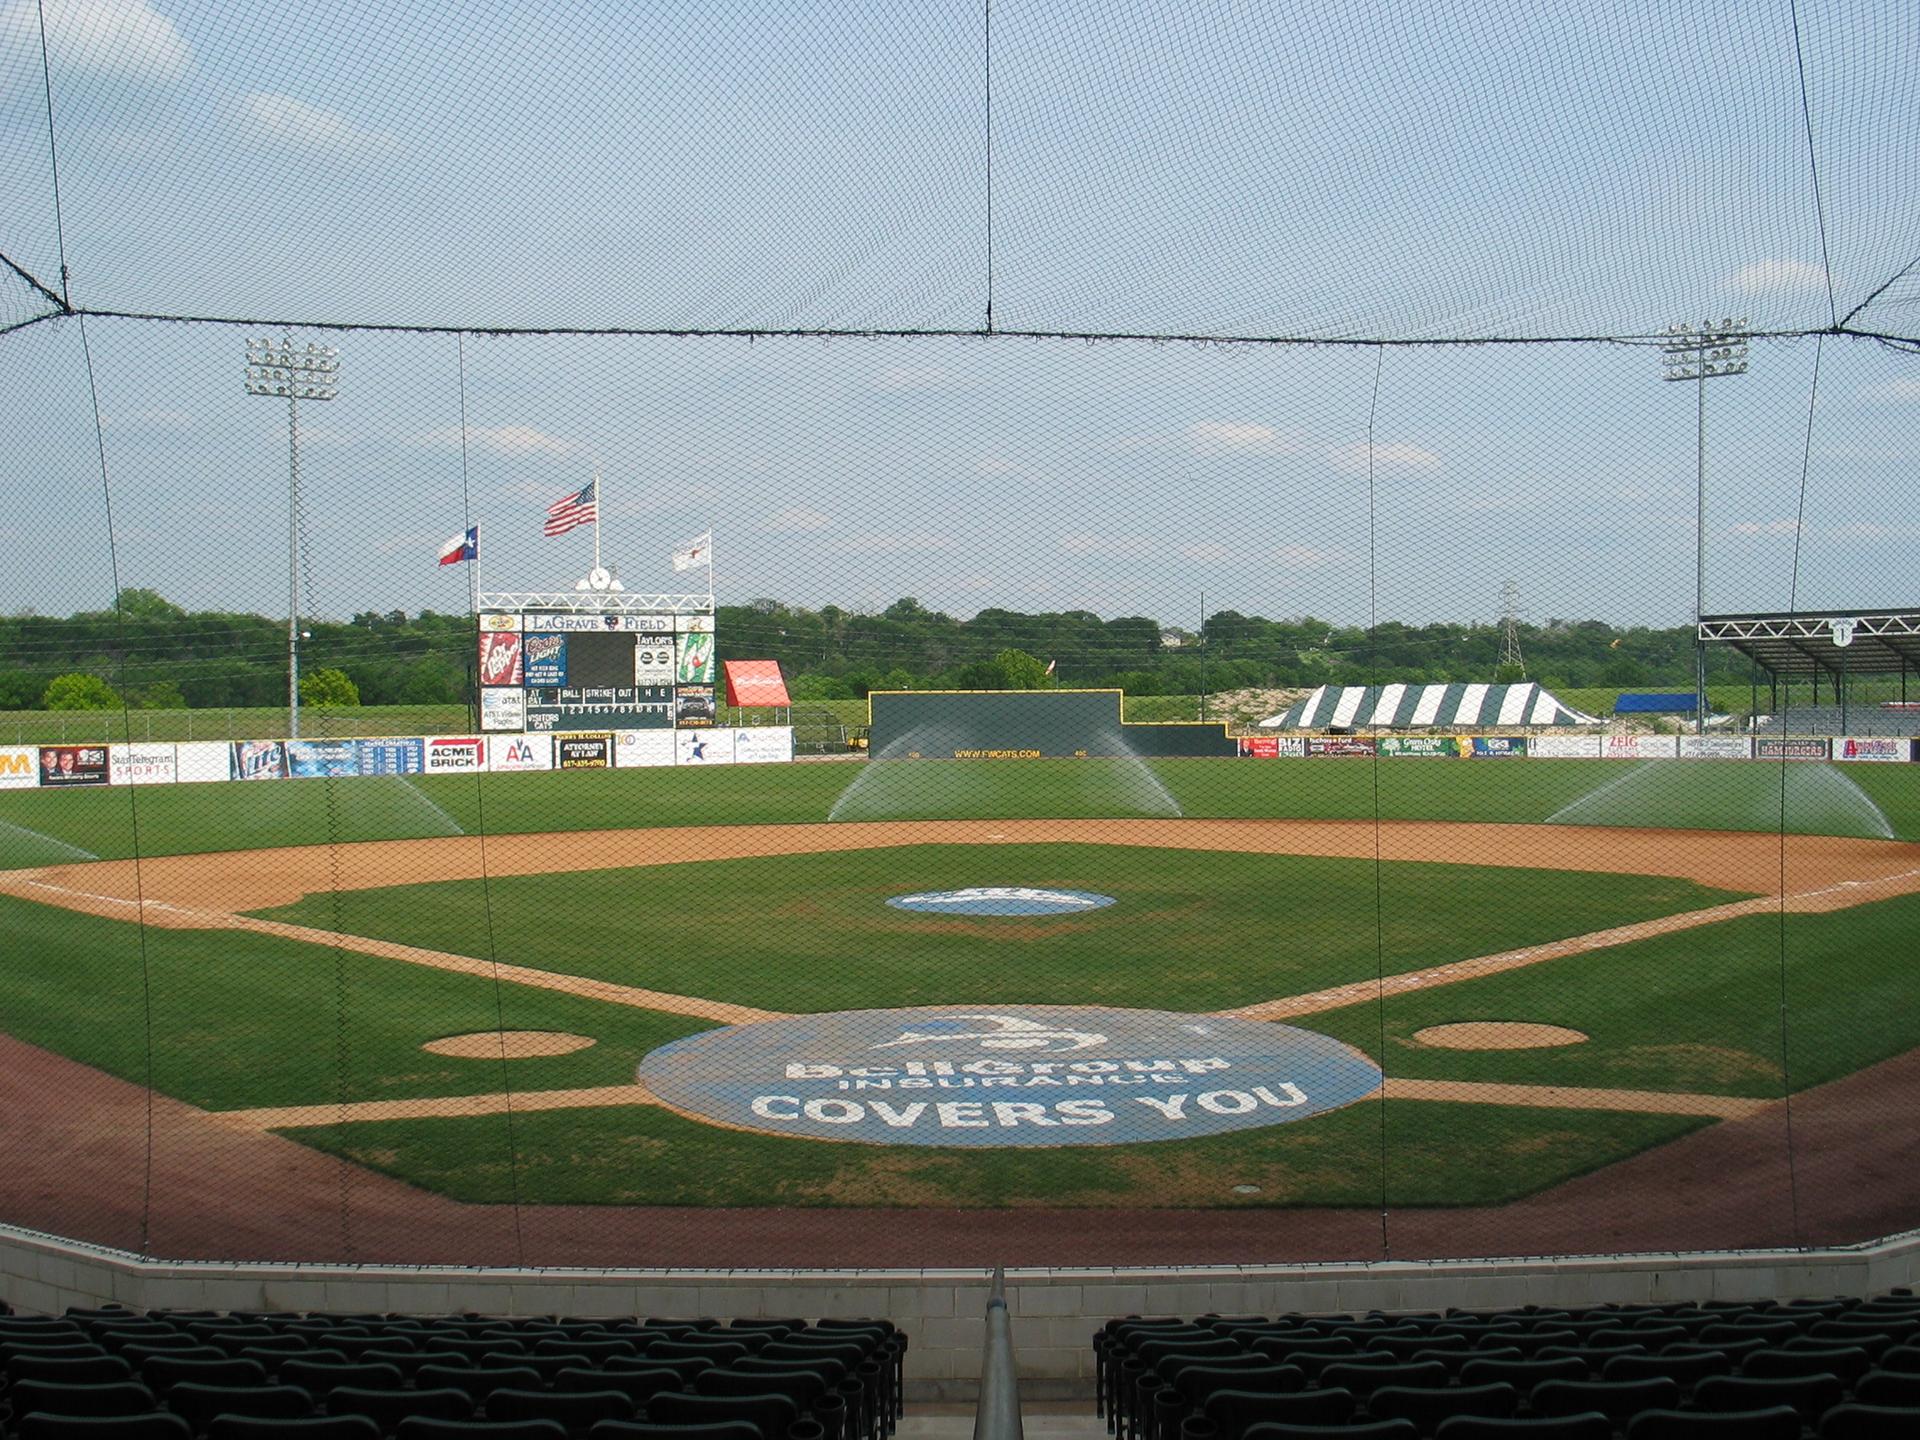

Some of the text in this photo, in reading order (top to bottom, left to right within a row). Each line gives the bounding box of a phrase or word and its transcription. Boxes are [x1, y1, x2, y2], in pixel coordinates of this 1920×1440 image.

[625, 616, 666, 630] FIELD
[562, 689, 581, 698] BALL
[585, 688, 612, 698] STRIKE
[618, 688, 632, 697] OUT
[569, 706, 576, 715] 2
[578, 706, 584, 714] 3
[594, 705, 601, 713] 5
[620, 705, 626, 713] 8
[628, 705, 633, 713] 9
[527, 714, 559, 722] VISITORS
[534, 721, 553, 730] CATS
[431, 747, 475, 757] ACME
[563, 743, 604, 752] ATTORNEY
[954, 749, 1041, 759] WWW.FWCATS.COM
[430, 758, 474, 767] BRICK
[838, 1073, 1190, 1091] INSURANCE
[751, 1081, 1309, 1129] COVERS YOU
